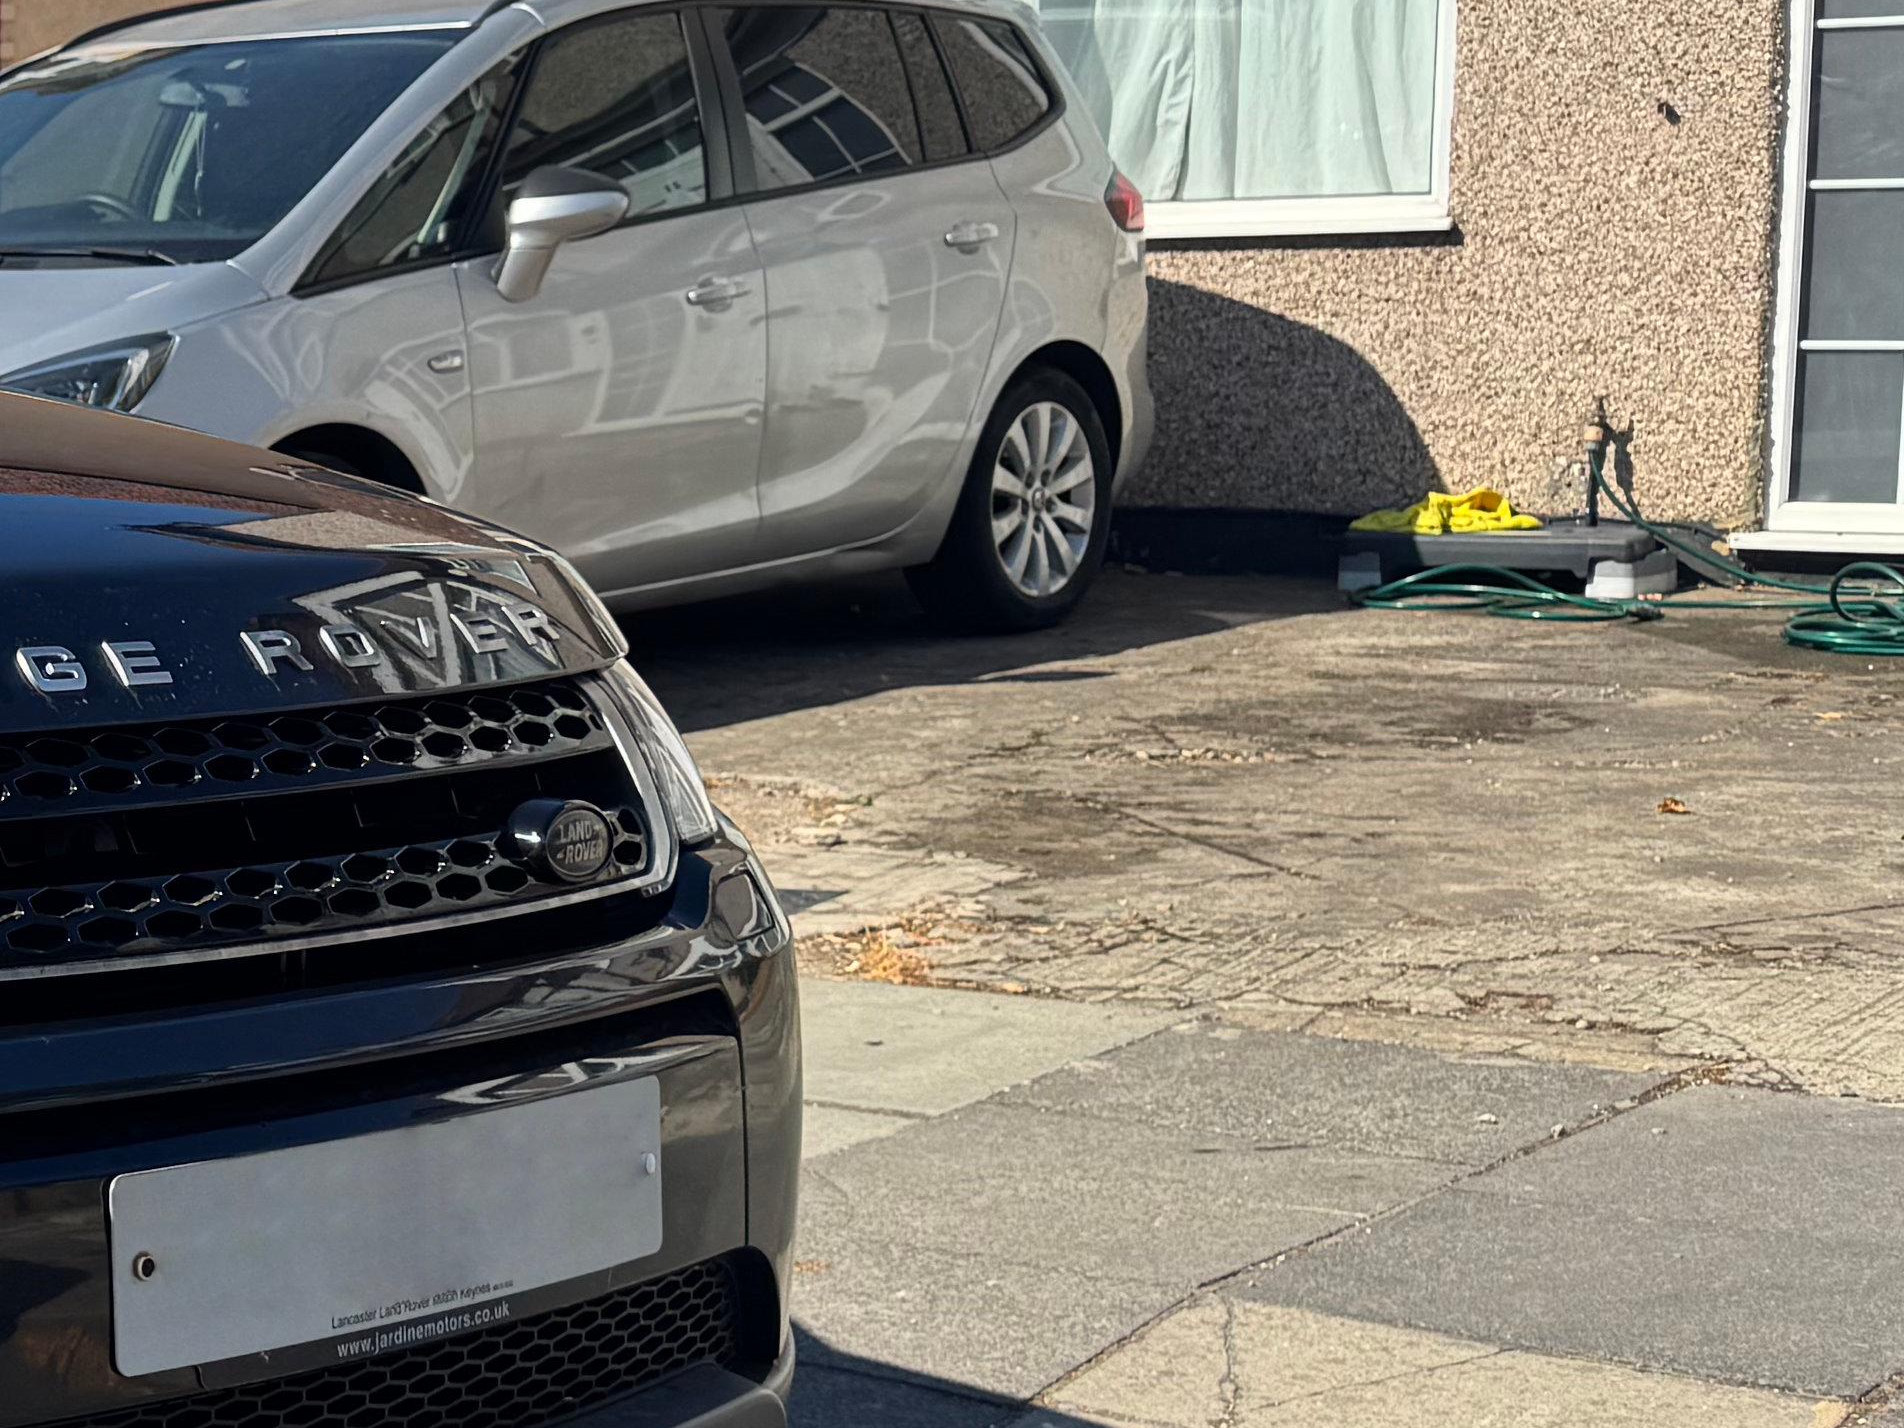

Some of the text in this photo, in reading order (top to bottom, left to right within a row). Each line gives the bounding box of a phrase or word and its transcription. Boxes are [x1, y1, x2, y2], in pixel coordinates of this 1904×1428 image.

[239, 604, 560, 676] ROVER
[559, 820, 593, 844] LAND
[565, 839, 604, 864] ROVER
[331, 1308, 378, 1329] Lancaster
[336, 1300, 510, 1359] www.jardinemotors.co.uk
